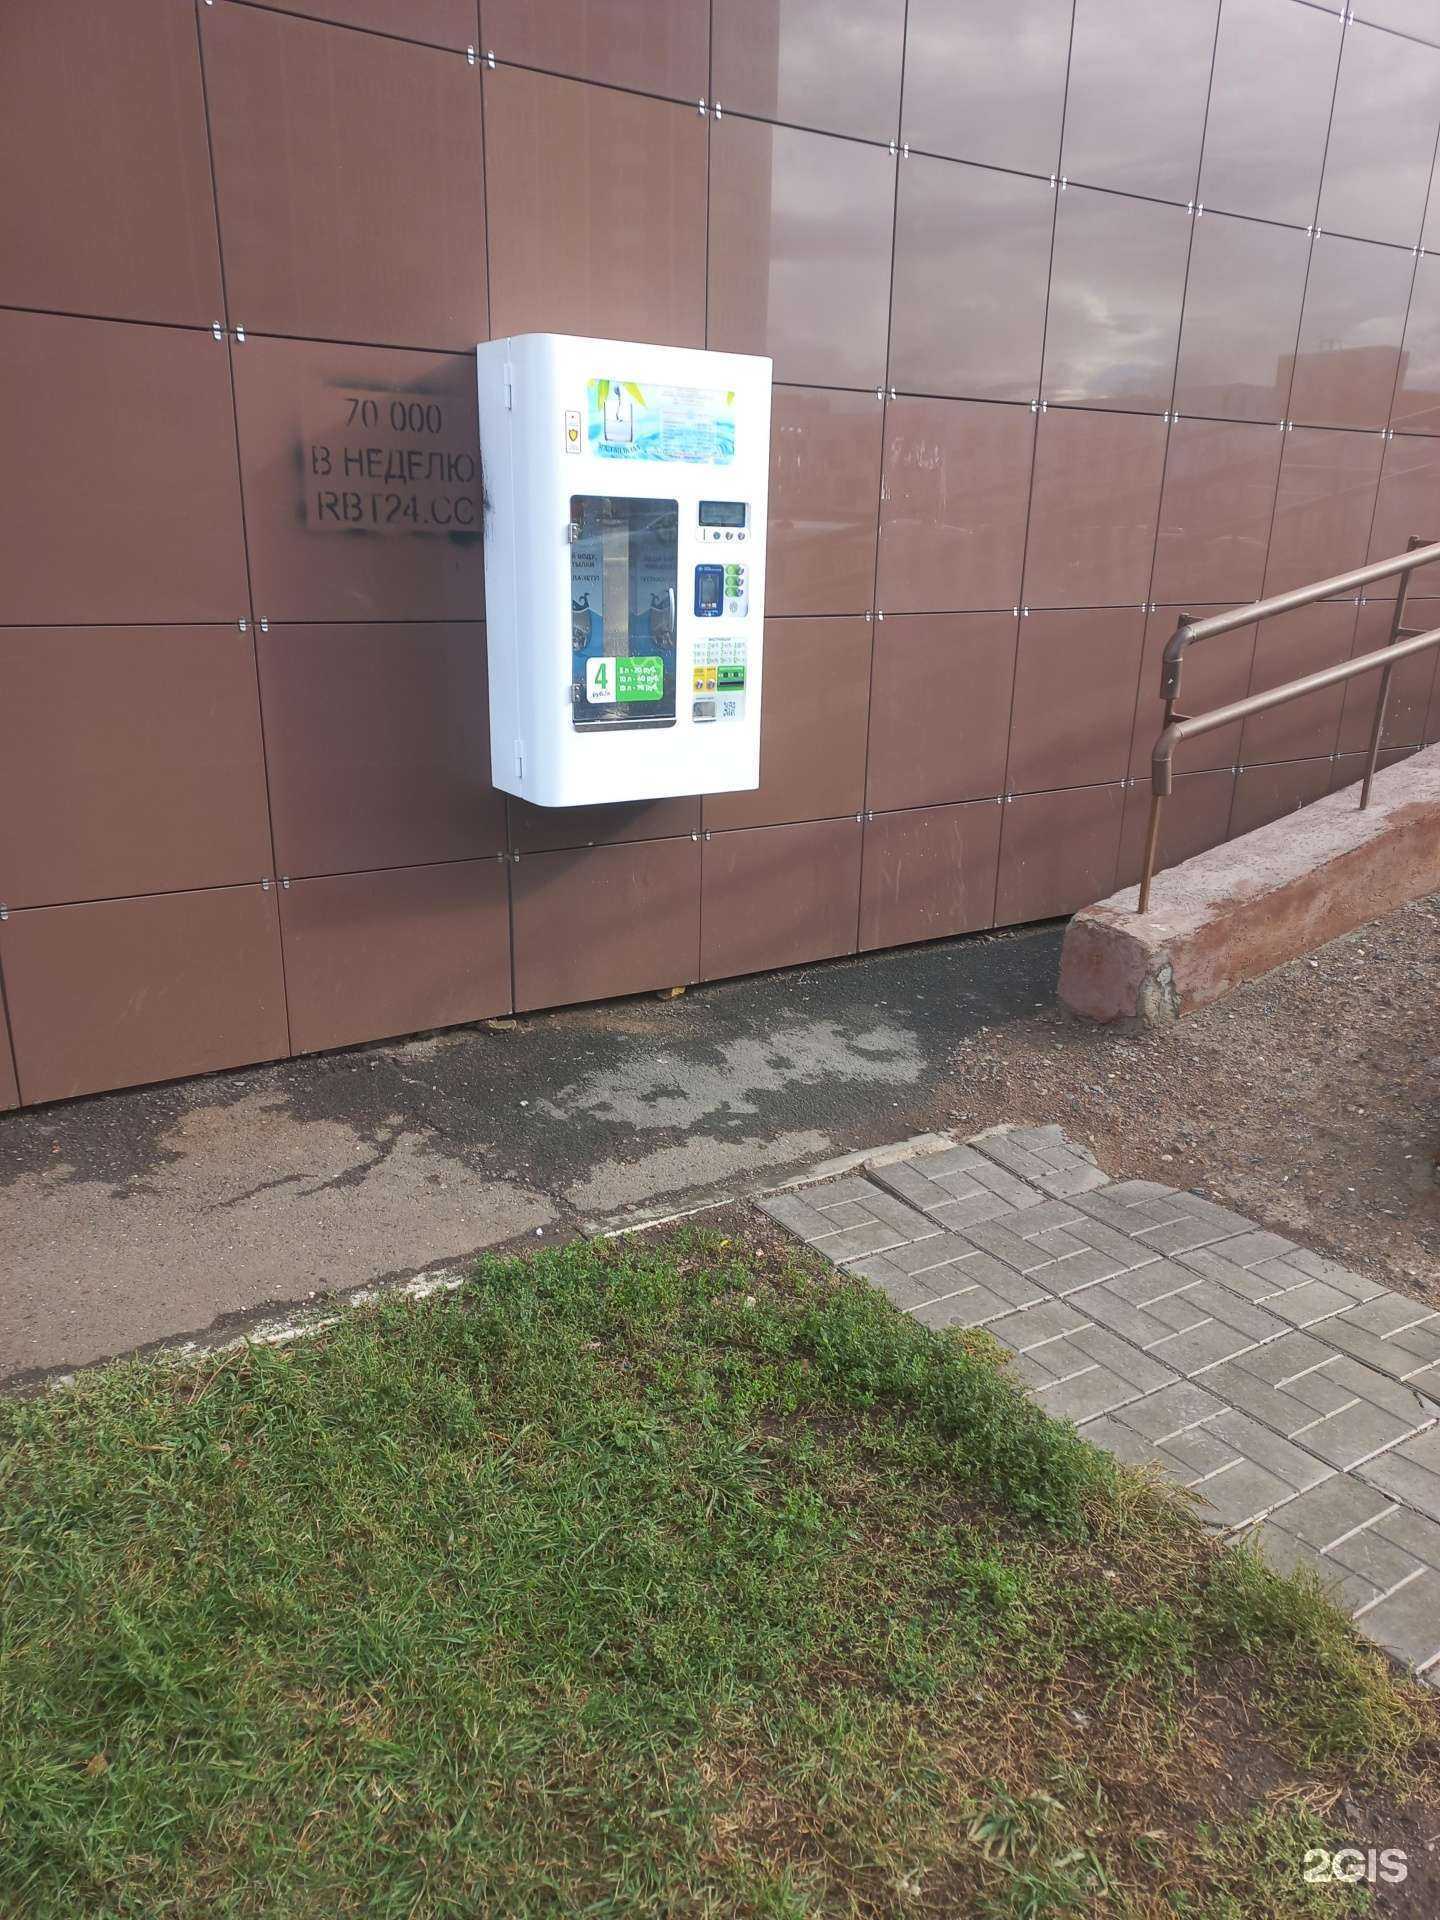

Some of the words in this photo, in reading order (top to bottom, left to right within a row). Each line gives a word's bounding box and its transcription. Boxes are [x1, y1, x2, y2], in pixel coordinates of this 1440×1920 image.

[344, 398, 379, 428] 70
[390, 401, 442, 434] 000
[311, 445, 332, 476] В
[343, 447, 475, 485] НЕДЕЛЮ
[594, 663, 608, 689] 4
